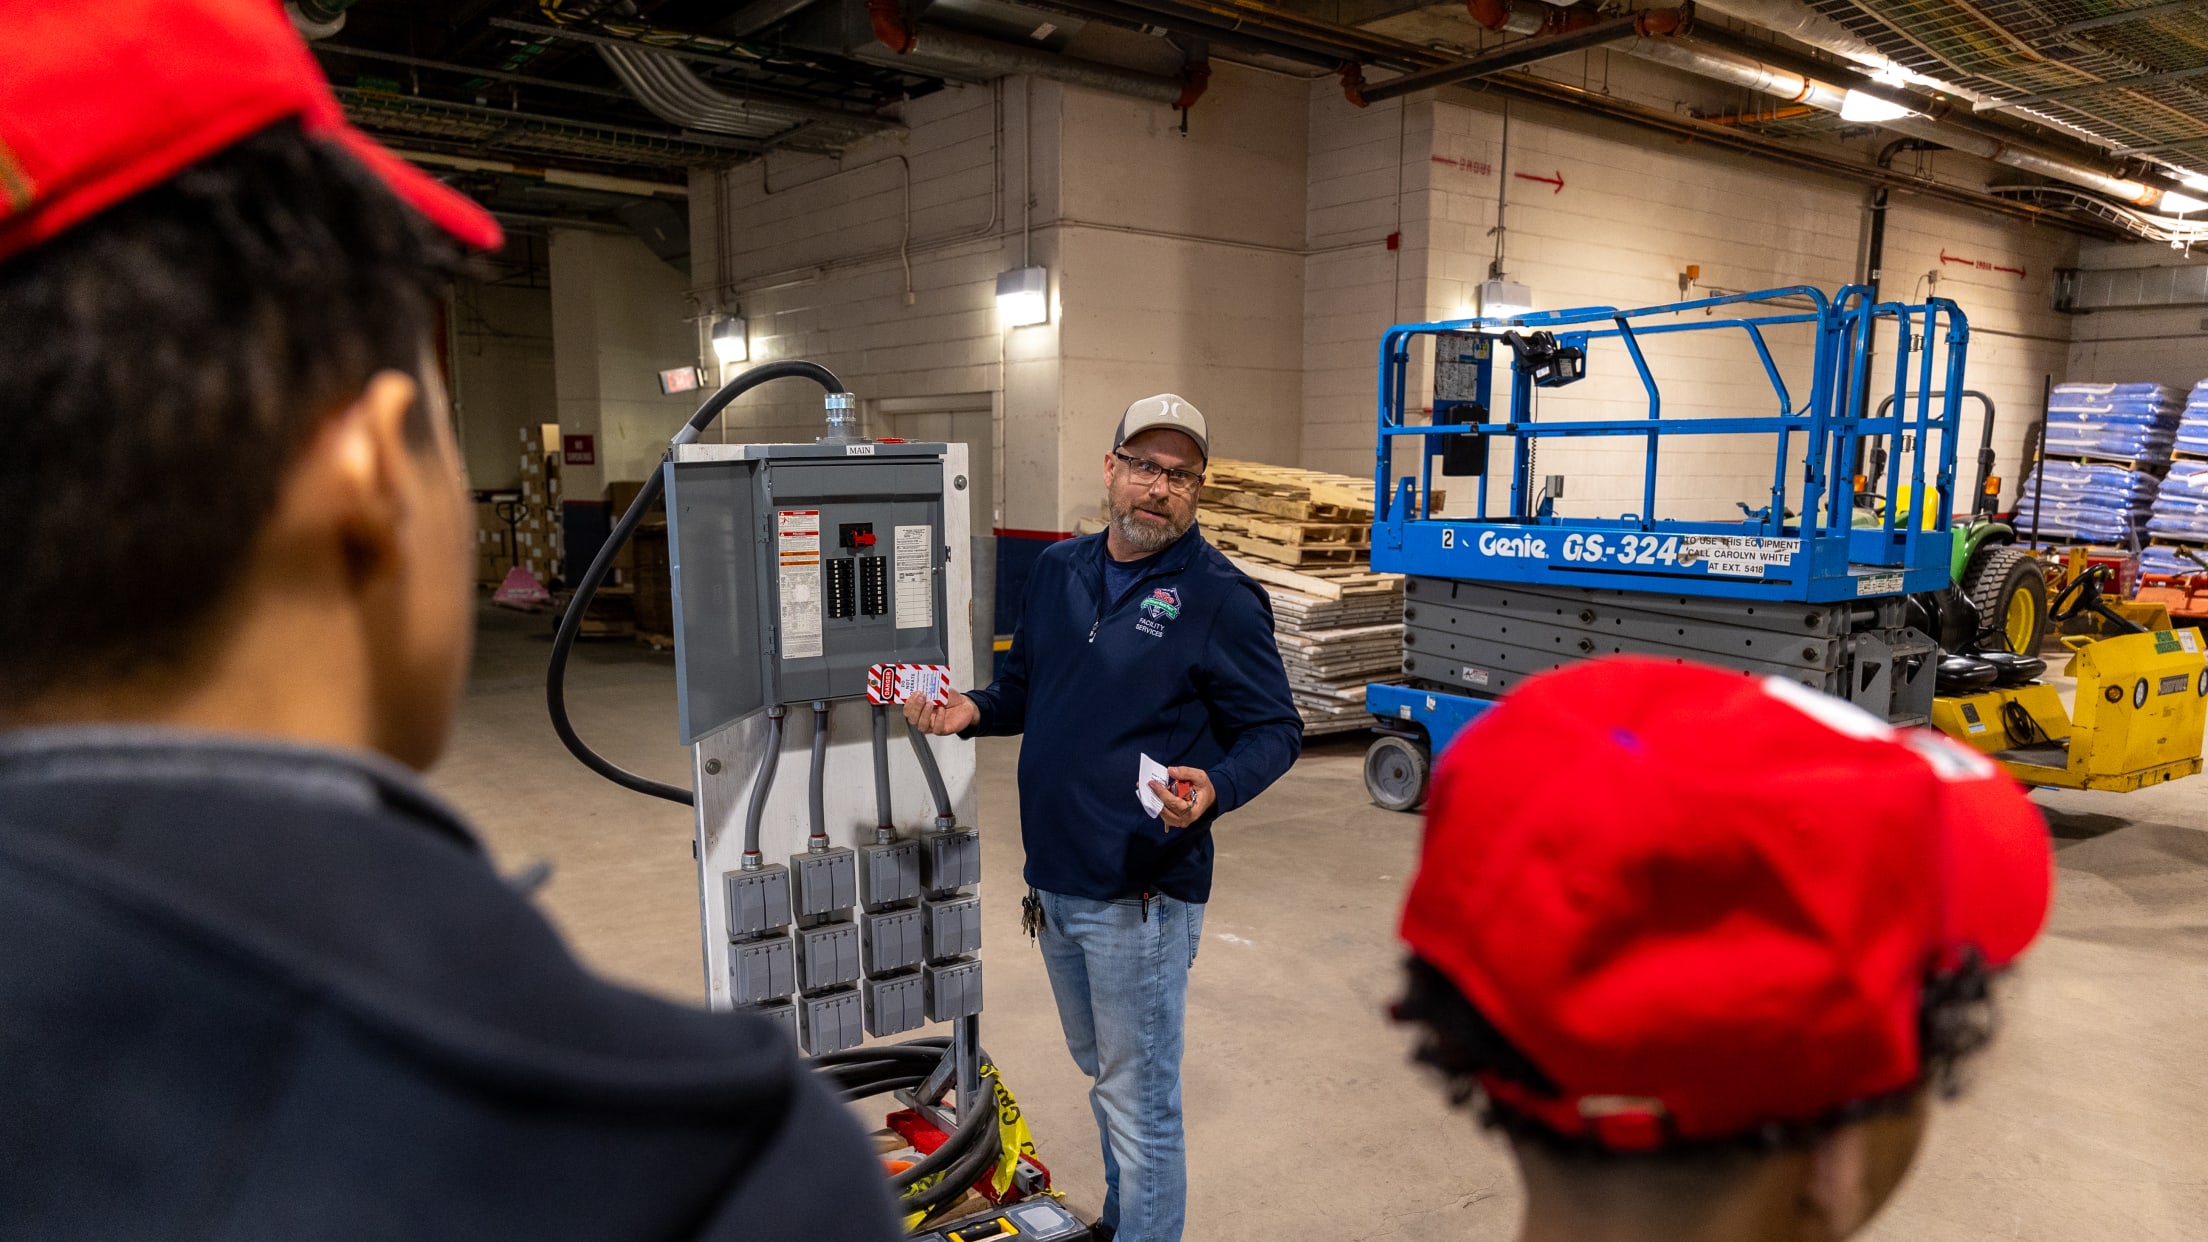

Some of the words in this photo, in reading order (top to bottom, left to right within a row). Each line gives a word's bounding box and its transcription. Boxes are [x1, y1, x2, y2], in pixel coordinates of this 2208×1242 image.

[849, 446, 871, 455] MAIN
[1444, 530, 1452, 547] 2
[1479, 530, 1547, 559] Genie
[1699, 536, 1717, 545] USE
[1688, 548, 1710, 558] CALL
[1714, 550, 1756, 560] CAROLYN
[1760, 552, 1790, 562] WHITE
[1708, 562, 1719, 570] AT
[1722, 563, 1741, 572] EXT.
[1744, 564, 1764, 574] 5418
[1135, 623, 1163, 637] SERVICES
[1138, 617, 1164, 631] FACILITY
[884, 671, 892, 696] DANGER
